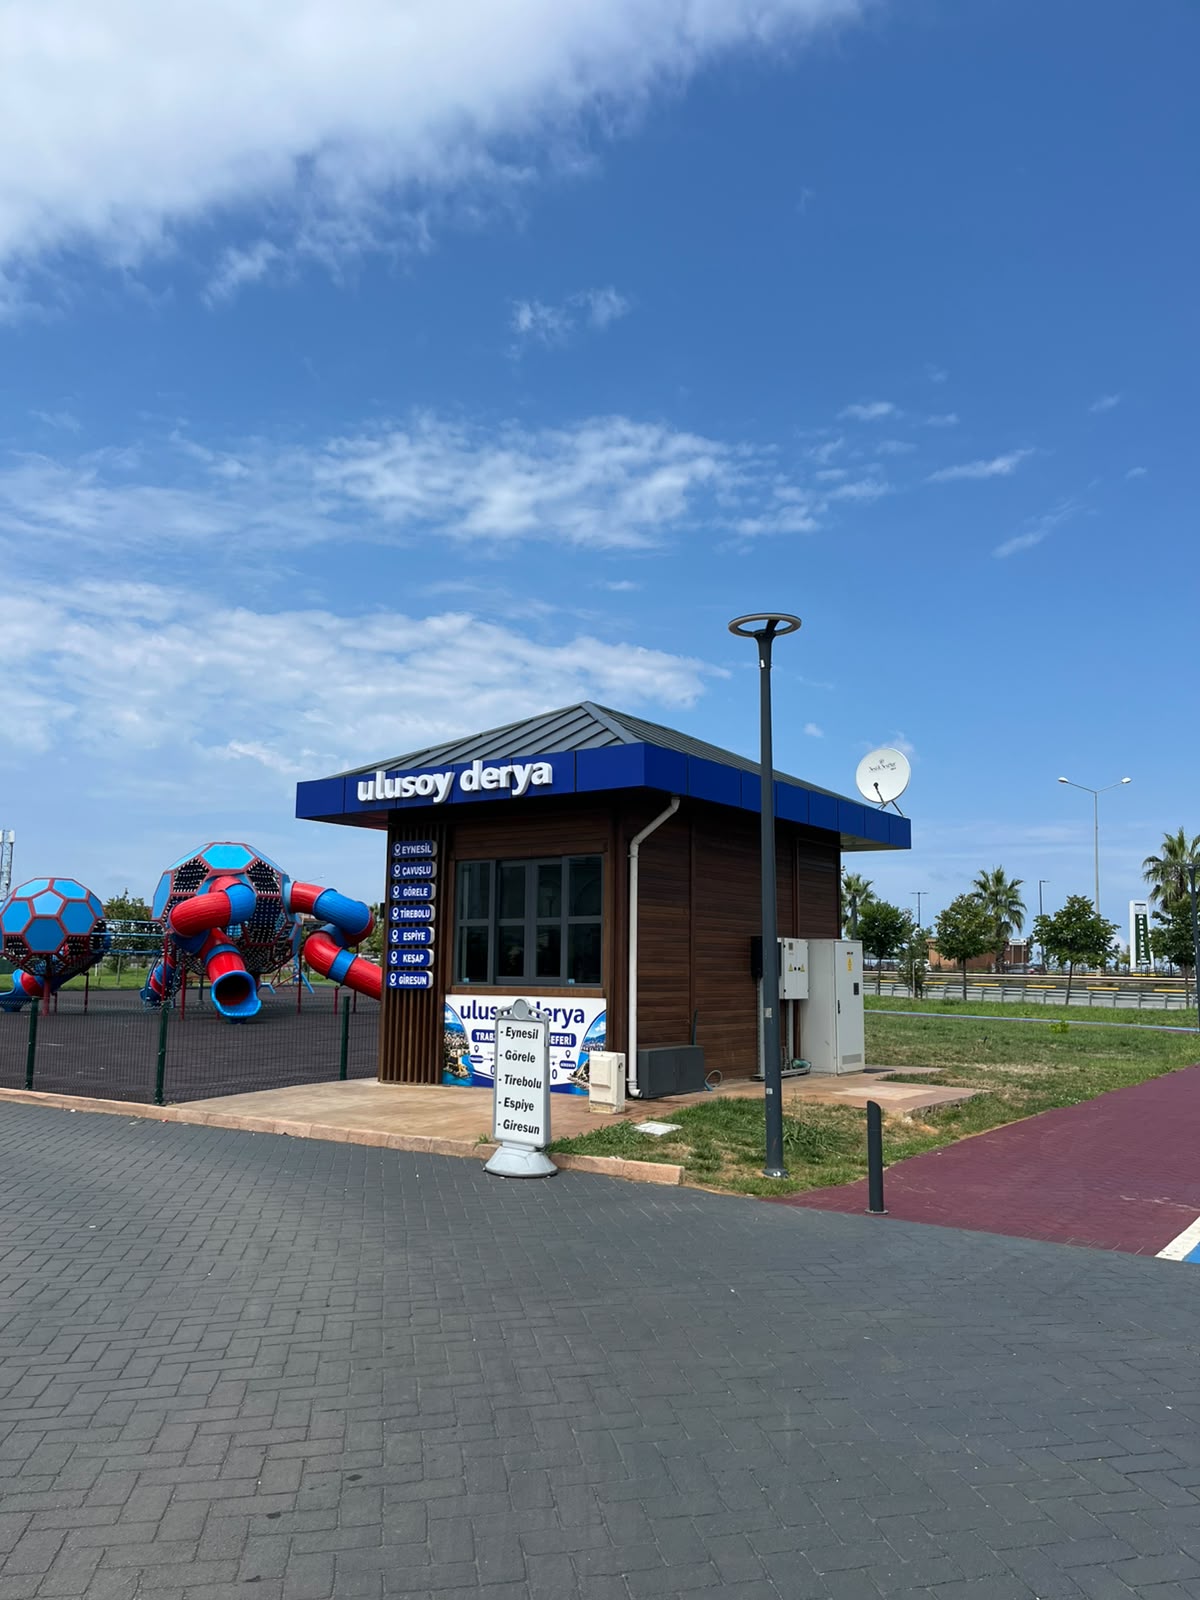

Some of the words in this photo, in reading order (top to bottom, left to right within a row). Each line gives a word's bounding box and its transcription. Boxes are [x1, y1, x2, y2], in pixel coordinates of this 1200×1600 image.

[357, 770, 455, 803] ulusoy
[460, 760, 553, 796] derya
[401, 843, 432, 854] EYNESİL
[402, 866, 432, 876] ÇAVUŞLU
[403, 886, 428, 897] GÖRELE
[400, 907, 430, 918] TİREBOLU
[403, 930, 426, 941] ESPİYE
[402, 954, 424, 964] KEŞAP
[398, 974, 427, 985] GİRESUN
[460, 999, 512, 1020] ulus
[475, 1031, 494, 1041] TRAB
[550, 1034, 572, 1046] EFERİ
[505, 1026, 539, 1040] Eynesil
[504, 1049, 536, 1063] Görele
[504, 1074, 542, 1089] Tirebolu
[503, 1097, 535, 1112] Espiye
[502, 1119, 540, 1135] Giresun
